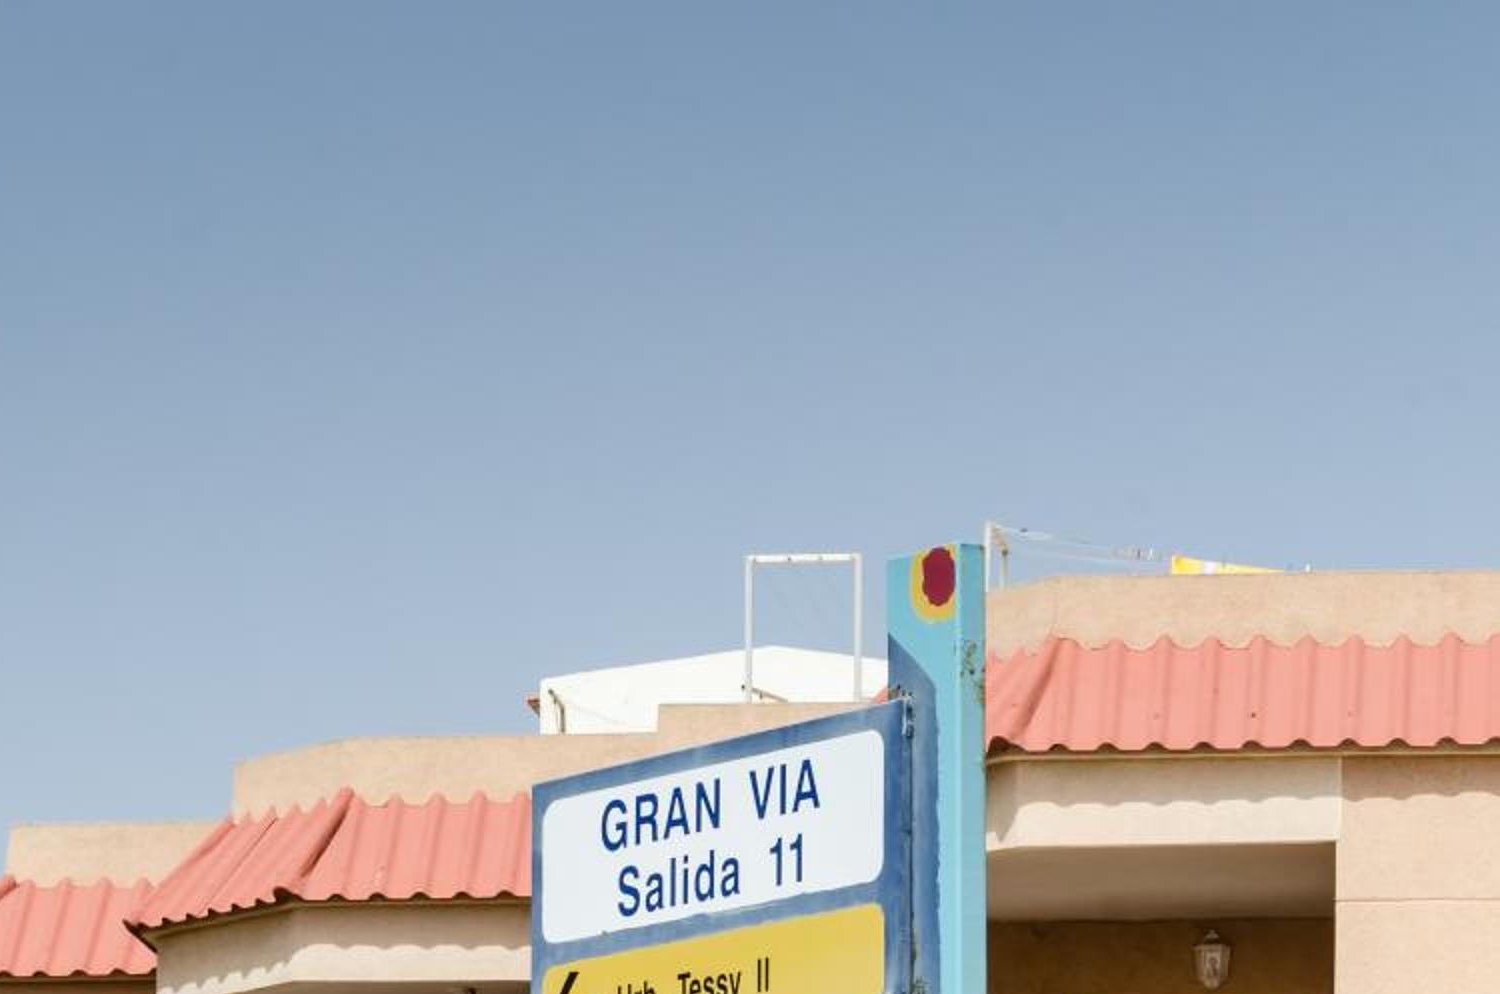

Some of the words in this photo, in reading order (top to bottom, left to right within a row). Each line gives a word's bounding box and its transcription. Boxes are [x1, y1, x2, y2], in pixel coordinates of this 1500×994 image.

[601, 778, 722, 852] GRAN
[749, 758, 821, 821] VIA
[617, 849, 741, 917] Salida
[769, 833, 804, 886] 11
